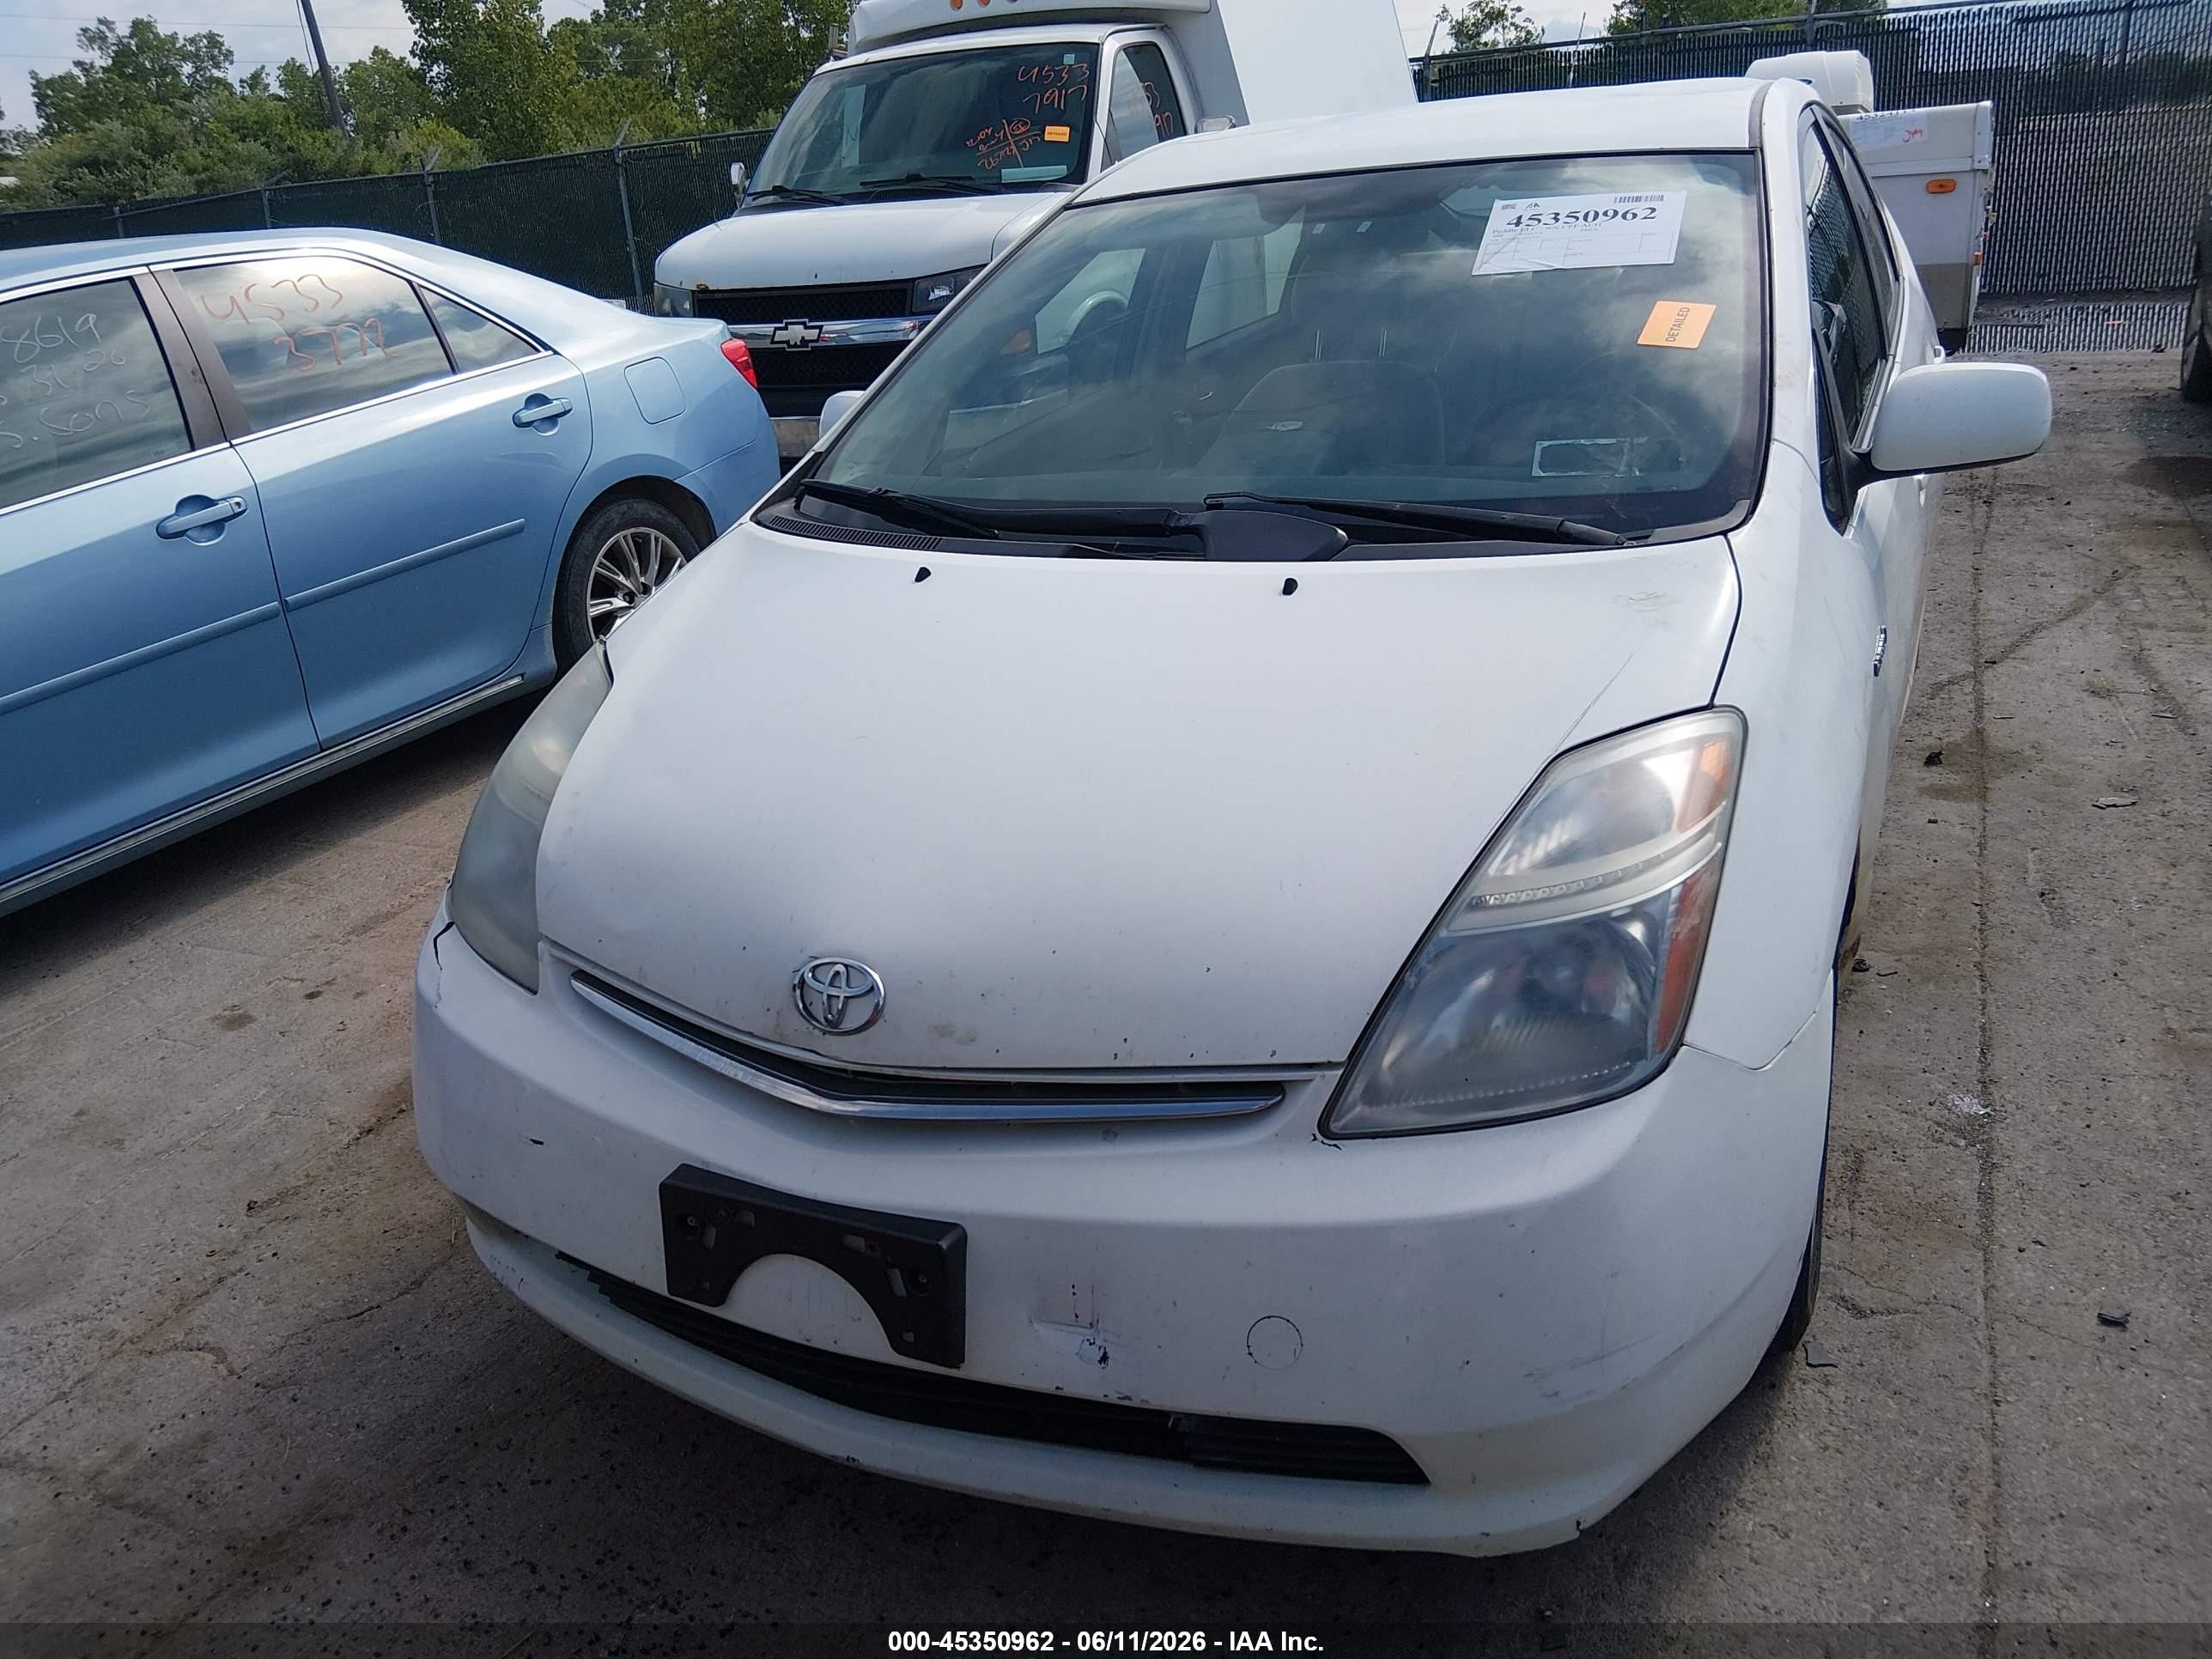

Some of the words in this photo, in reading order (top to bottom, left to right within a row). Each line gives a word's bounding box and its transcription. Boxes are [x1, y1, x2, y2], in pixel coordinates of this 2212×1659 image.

[1017, 64, 1091, 86] 4533
[1023, 85, 1088, 114] 7917
[1506, 207, 1658, 228] 45350962
[0, 313, 101, 363] 8619
[1664, 307, 1691, 343] DETAILED
